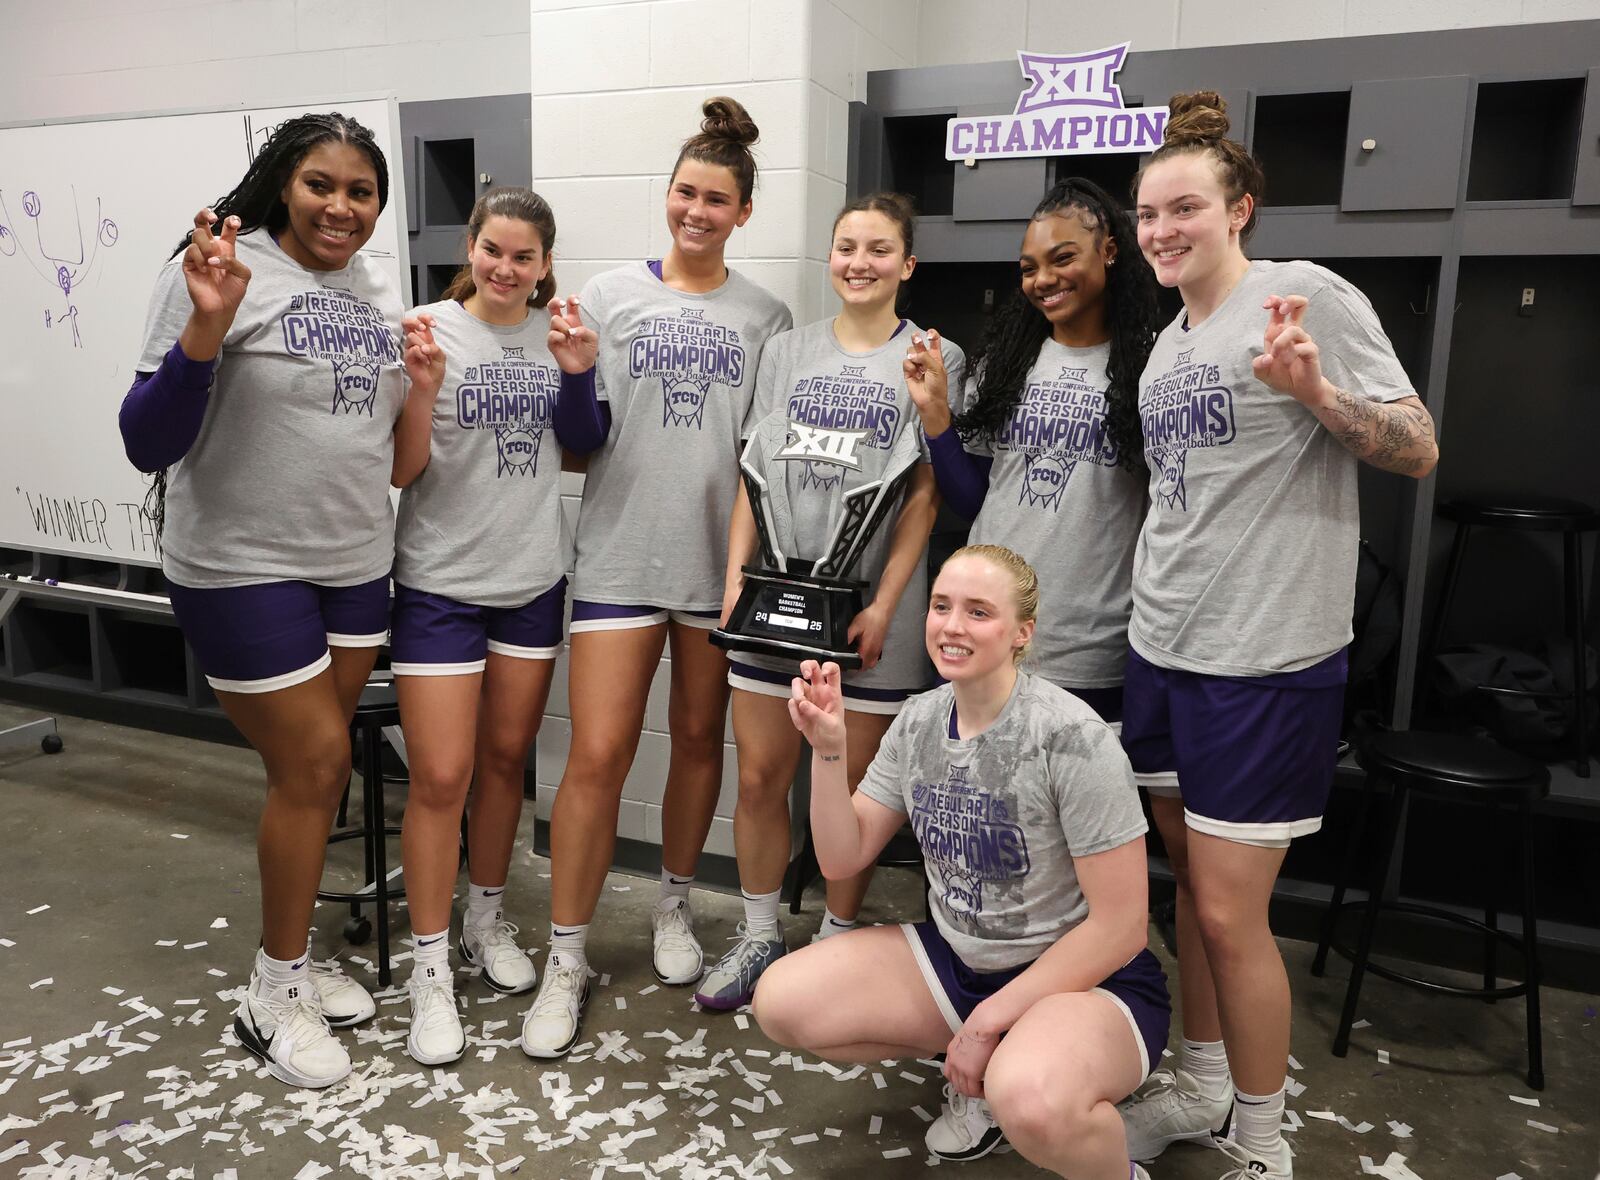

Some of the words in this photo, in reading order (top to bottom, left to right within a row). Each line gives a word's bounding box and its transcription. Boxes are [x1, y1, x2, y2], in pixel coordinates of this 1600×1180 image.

[290, 295, 304, 312] 20
[311, 298, 372, 317] REGULAR
[318, 312, 372, 328] SEASON
[658, 322, 721, 338] REGULAR
[288, 317, 397, 362] CHAMPIONS
[661, 333, 717, 348] SEASON
[306, 346, 352, 362] Women's
[632, 338, 742, 381] CHAMPIONS
[464, 367, 478, 380] 20
[486, 368, 546, 381] REGULAR
[641, 367, 682, 378] Women's
[684, 368, 731, 386] Basketball
[1206, 365, 1220, 382] 25
[344, 376, 372, 392] TCU
[490, 381, 545, 394] SEASON
[794, 379, 809, 392] 20
[812, 381, 877, 398] REGULAR
[1060, 382, 1096, 392] CONFERENCE
[1152, 371, 1200, 398] REGULAR
[672, 392, 700, 406] TCU
[812, 393, 868, 409] SEASON
[884, 387, 896, 402] 25
[1030, 388, 1102, 409] REGULAR
[1150, 388, 1192, 412] SEASON
[462, 388, 560, 424] CHAMPION
[1030, 402, 1094, 422] SEASON
[474, 418, 515, 430] Women's
[518, 418, 554, 430] Basketba
[1142, 393, 1228, 449] HAMPIONS
[506, 440, 534, 455] TCU
[779, 421, 869, 467] XII
[1009, 440, 1048, 455] Women's
[1049, 444, 1104, 466] Basketball
[1032, 468, 1062, 486] TCU
[778, 598, 806, 608] BASKETBALL
[778, 606, 804, 614] CHAMPION
[756, 612, 768, 622] 24
[810, 620, 822, 631] 25
[930, 792, 982, 816] REGULAR
[932, 810, 978, 834] SEASON
